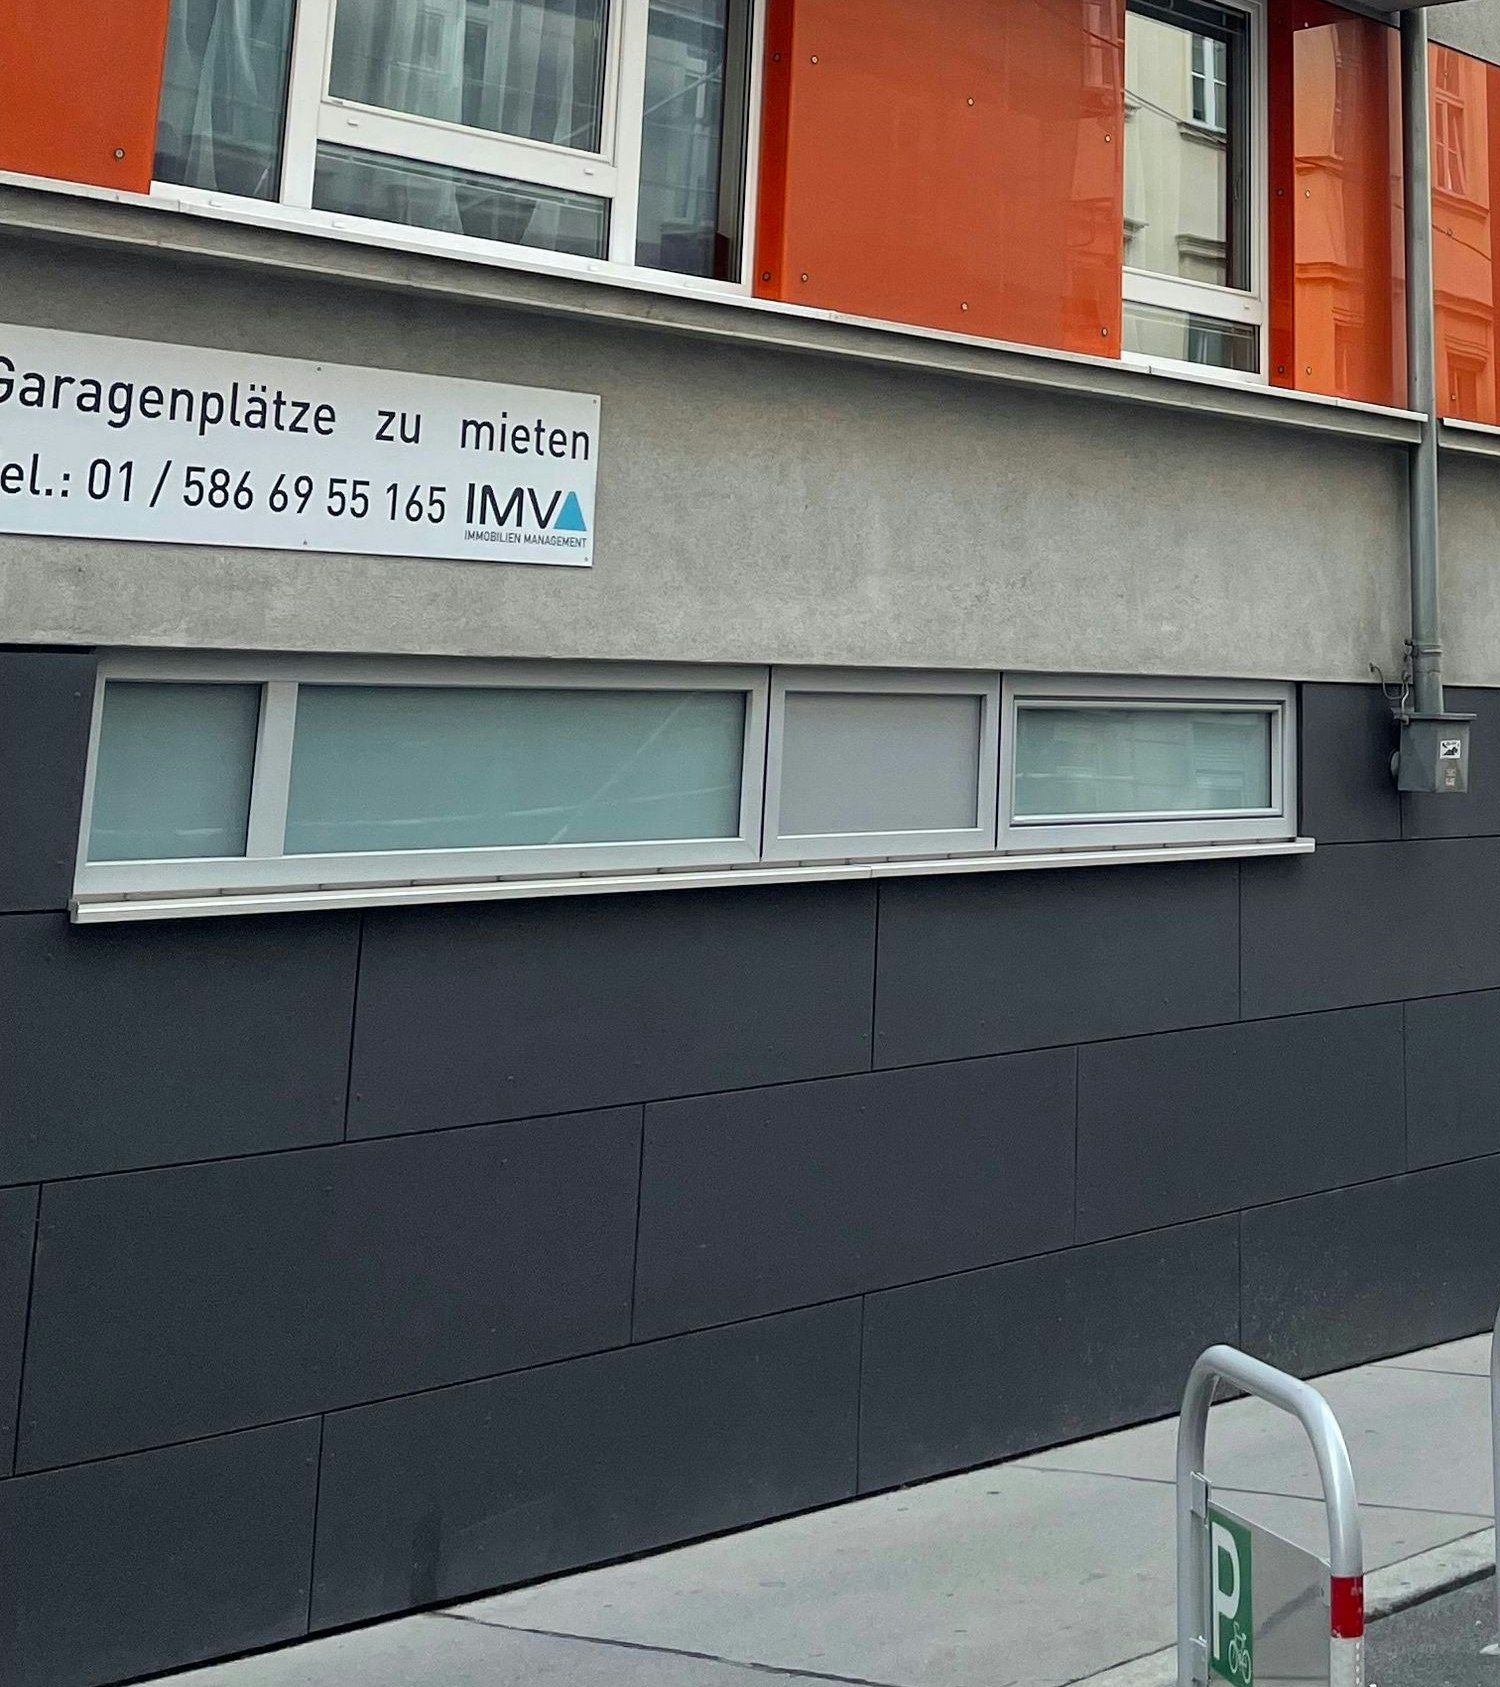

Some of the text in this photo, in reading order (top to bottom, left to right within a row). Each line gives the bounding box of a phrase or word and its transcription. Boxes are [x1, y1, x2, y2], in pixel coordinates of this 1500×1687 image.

[0, 356, 590, 460] Garagenplätze zu mieten
[0, 453, 446, 524] el.: 01 / 586 69 55 165
[464, 529, 587, 548] IMMOBILIEN MANAGEMENT
[1211, 1520, 1241, 1661] P
